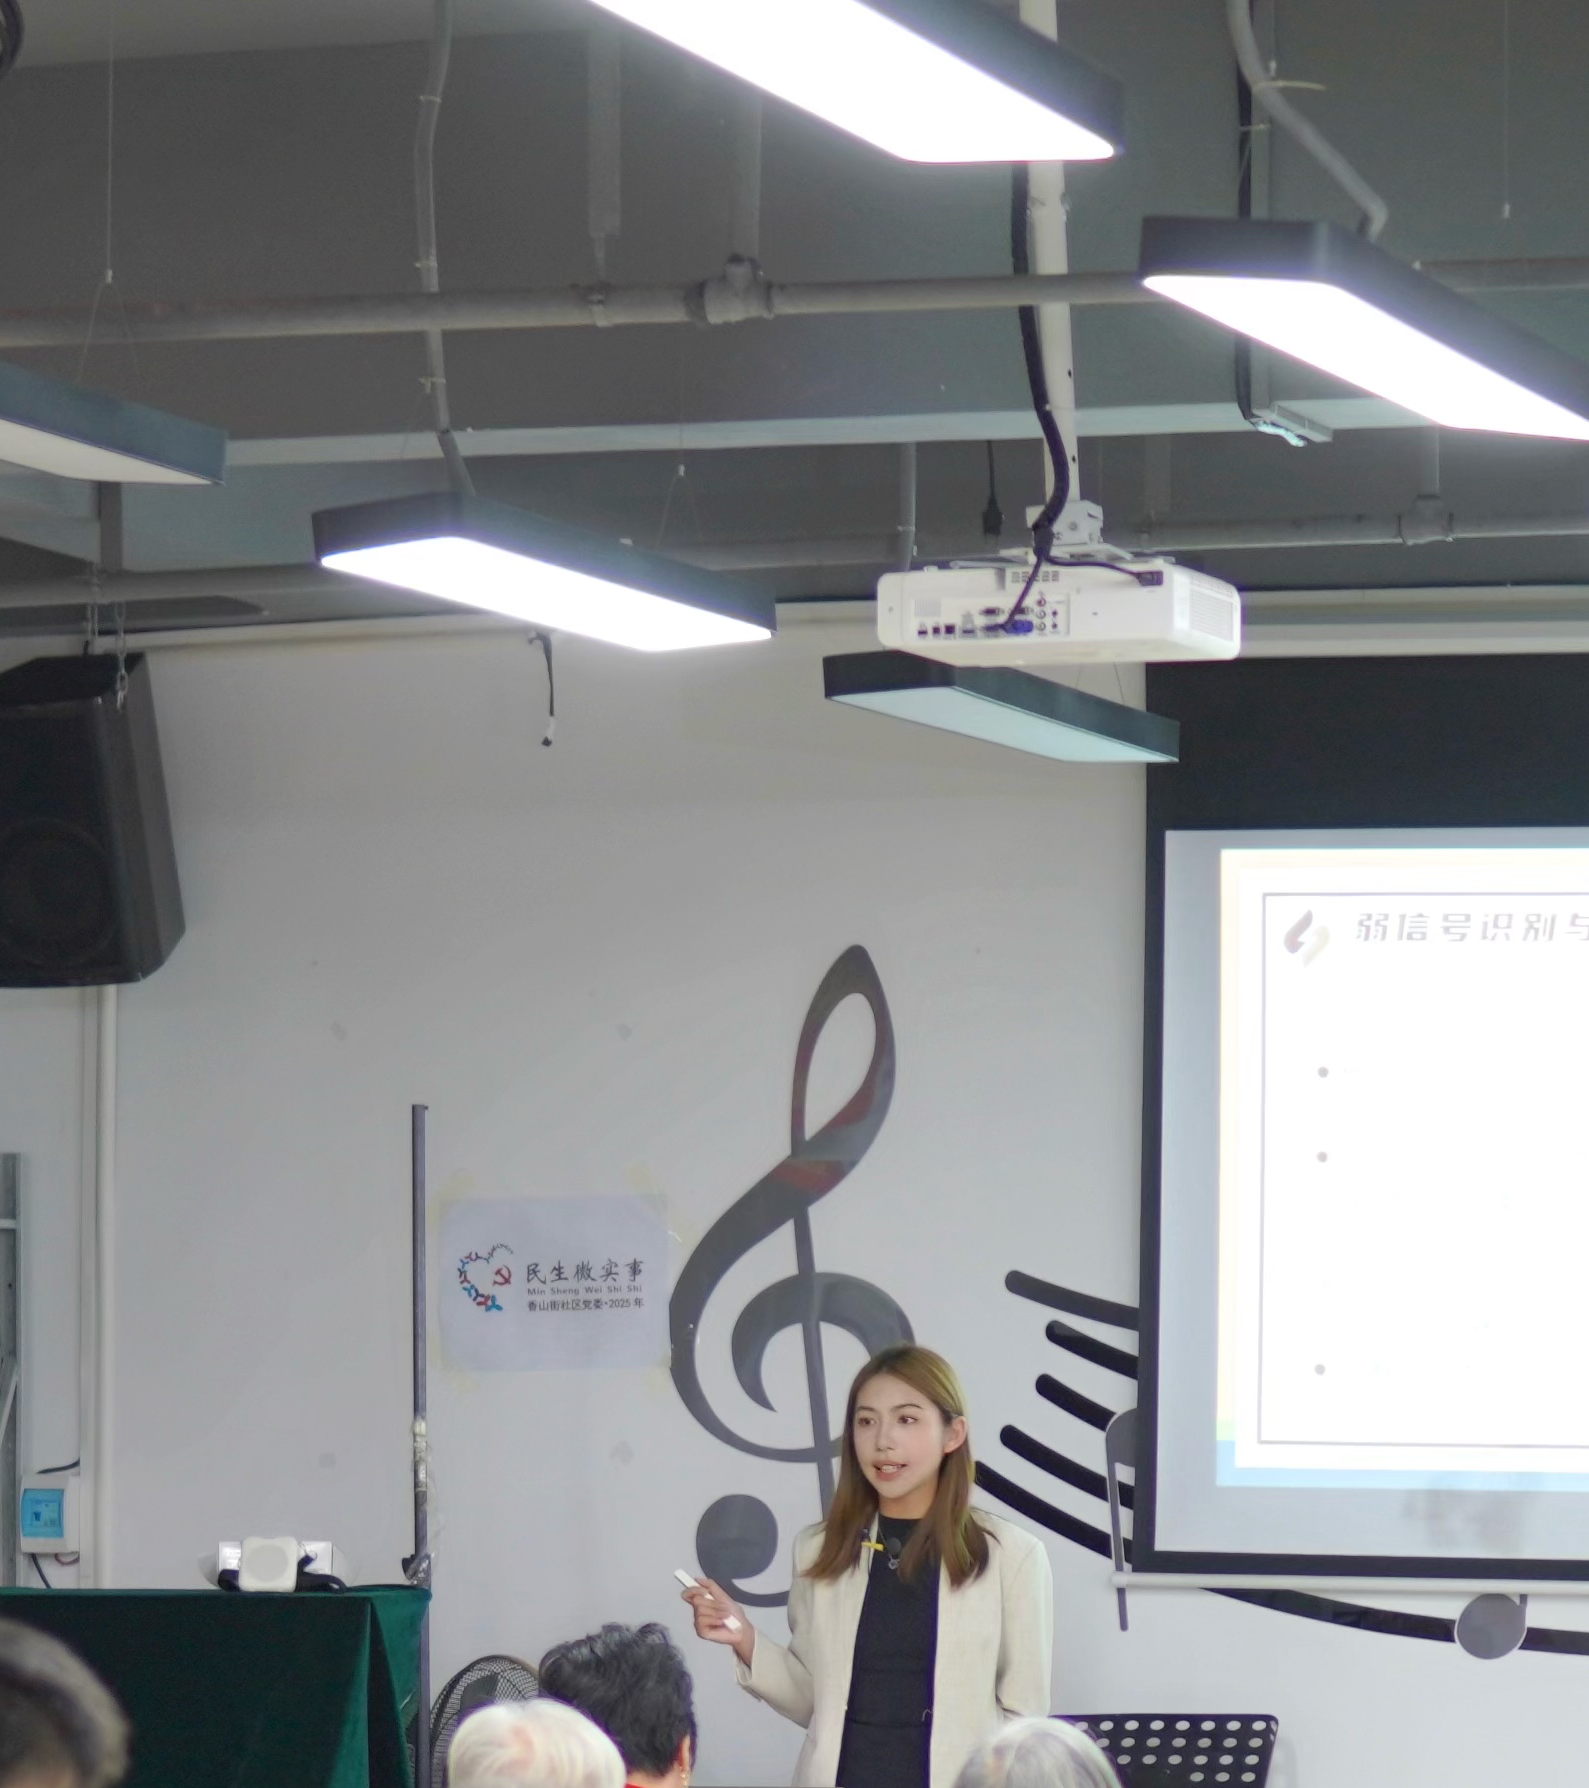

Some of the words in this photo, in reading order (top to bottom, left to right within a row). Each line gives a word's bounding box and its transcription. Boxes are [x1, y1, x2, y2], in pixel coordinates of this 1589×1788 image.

[526, 1258, 644, 1284] 民生微实事
[527, 1287, 546, 1296] Min
[550, 1286, 580, 1296] Sheng
[584, 1286, 603, 1294] Wei
[607, 1285, 622, 1293] Shi
[627, 1284, 642, 1293] Shi
